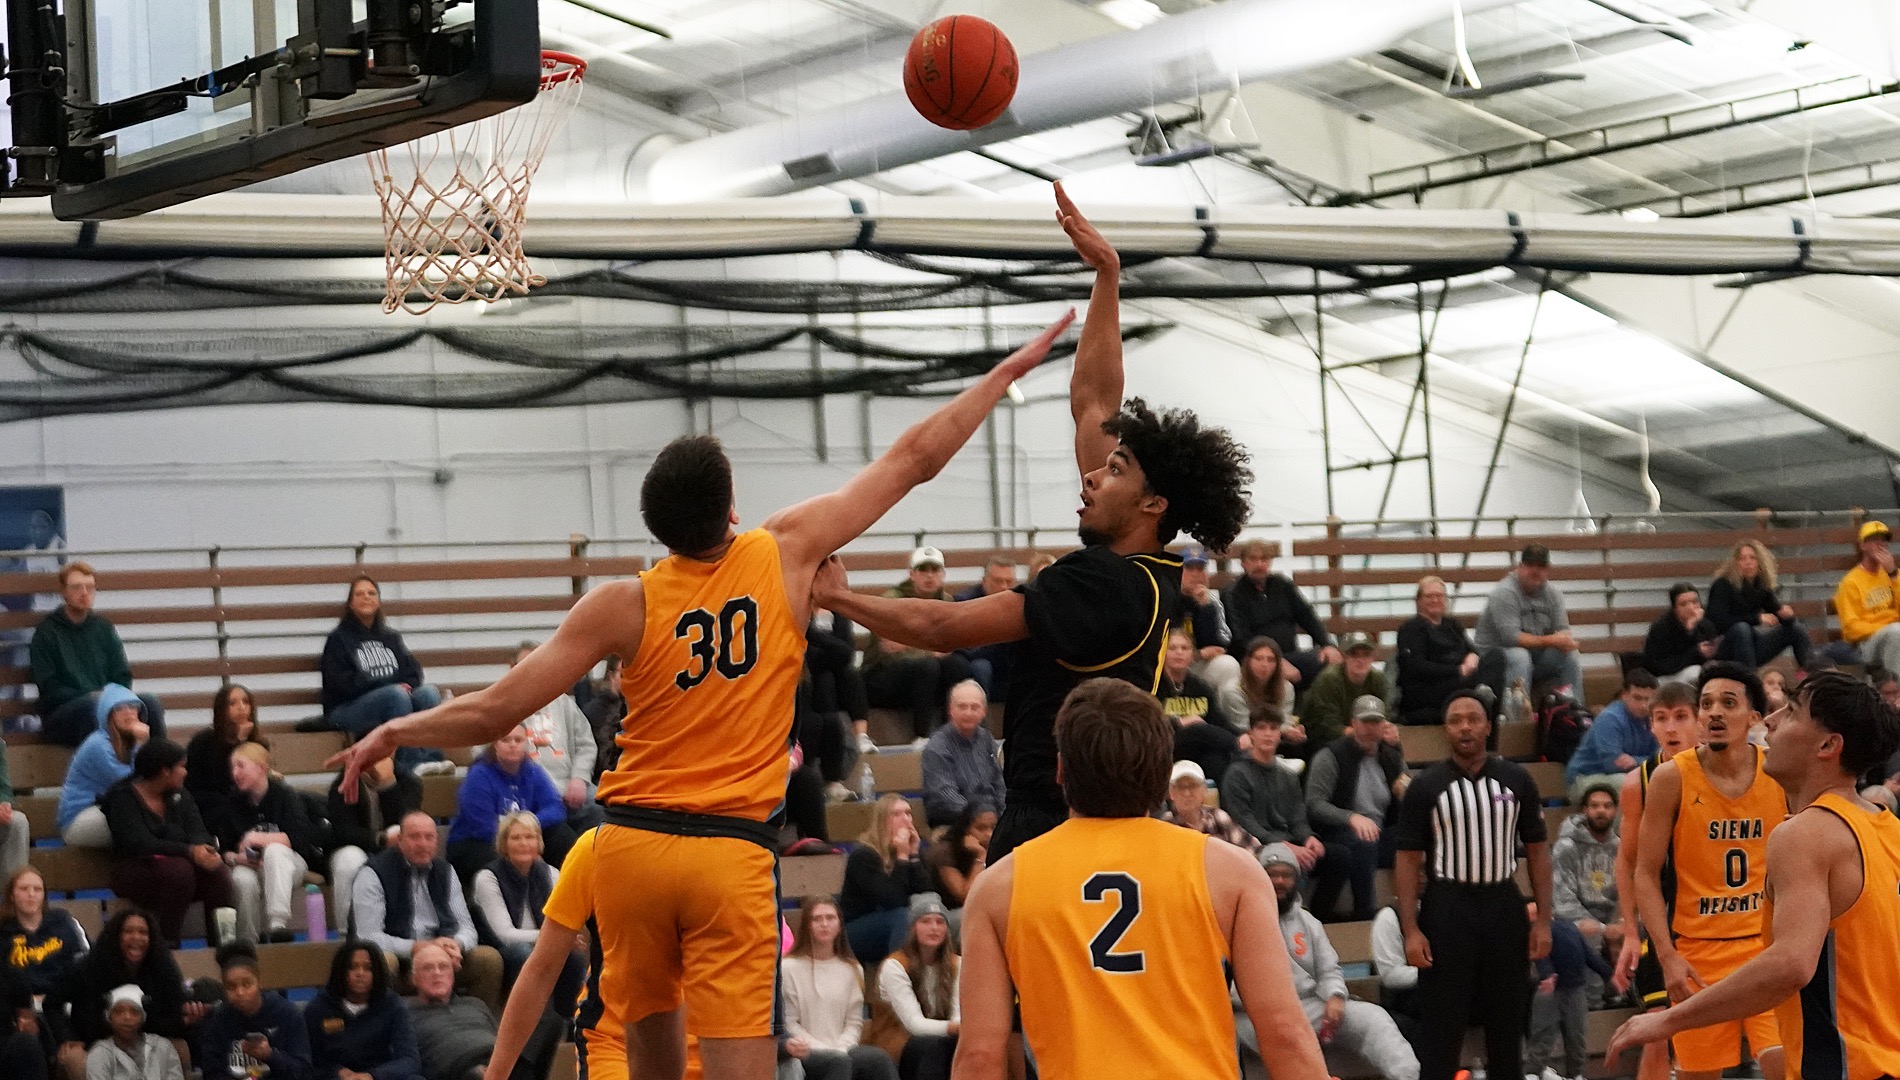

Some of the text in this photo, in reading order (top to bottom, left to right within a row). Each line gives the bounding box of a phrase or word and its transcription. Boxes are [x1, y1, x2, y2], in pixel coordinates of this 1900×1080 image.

[674, 593, 759, 692] 30
[1708, 818, 1763, 840] SIENA
[1725, 848, 1749, 889] 0
[1699, 890, 1764, 915] HEIGHT
[1082, 871, 1146, 974] 2
[1294, 932, 1306, 956] S
